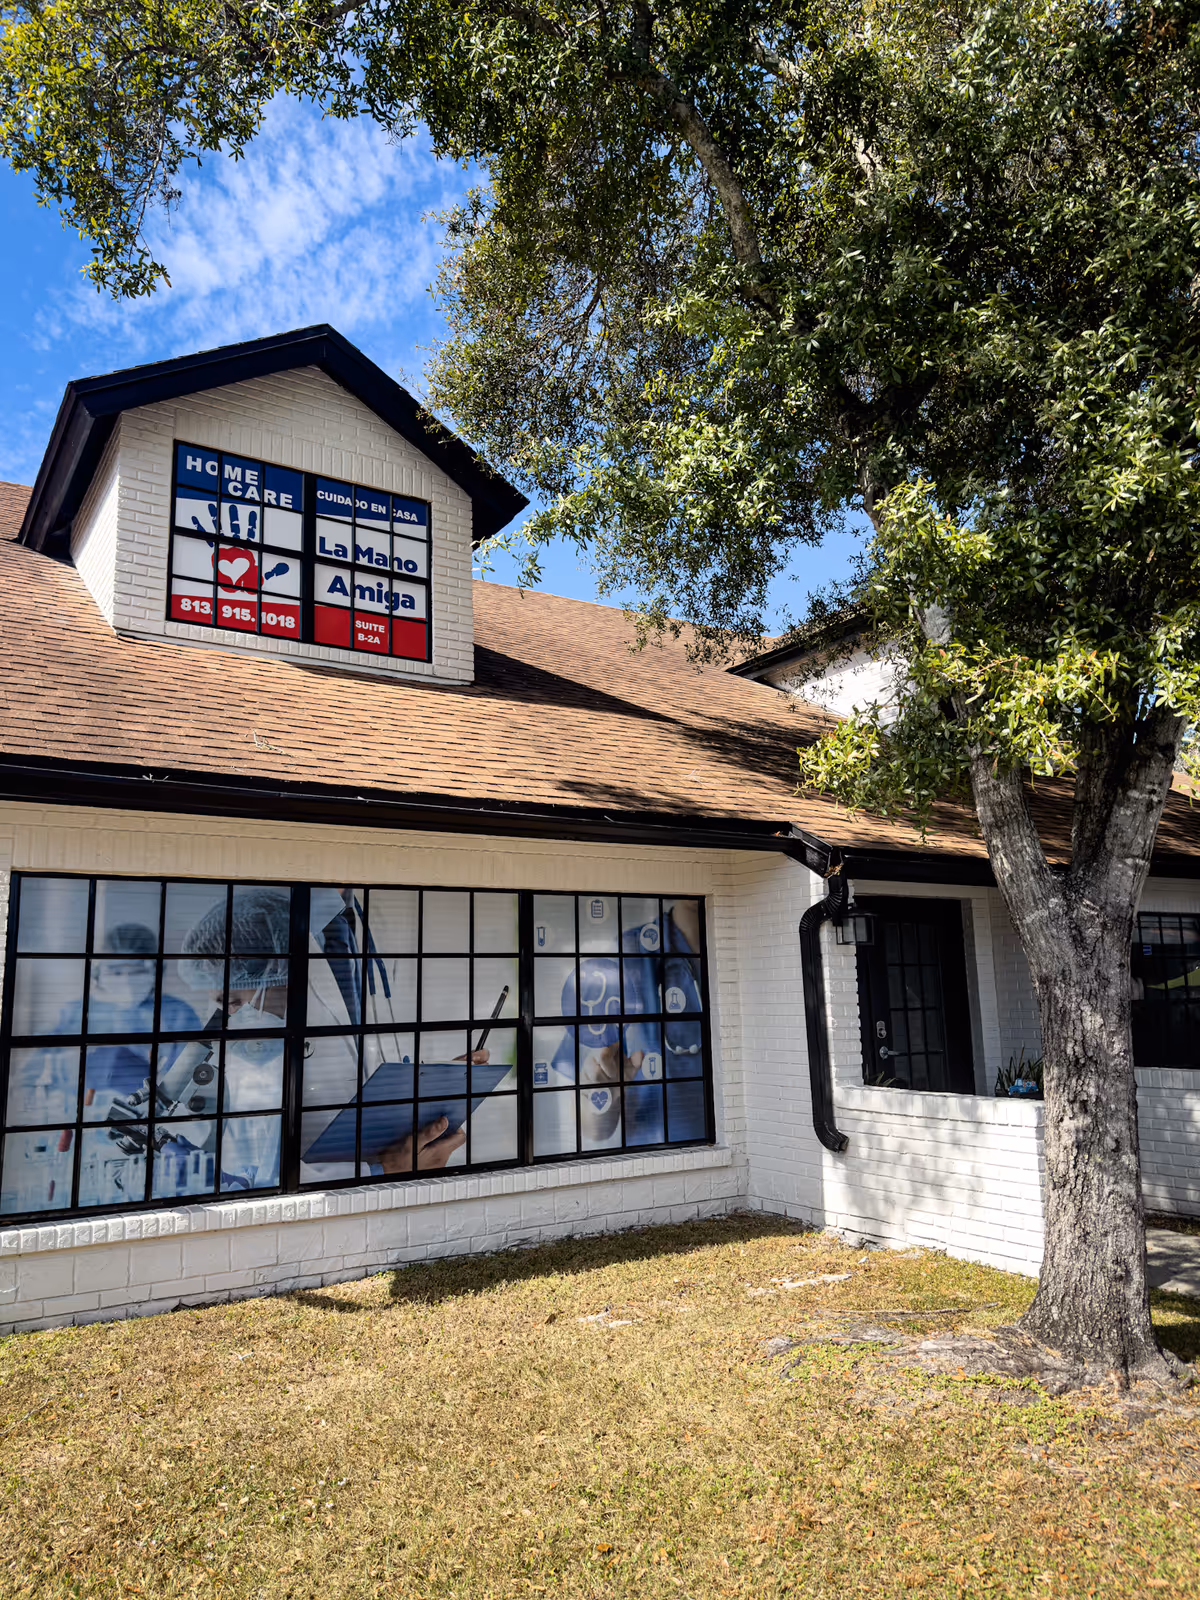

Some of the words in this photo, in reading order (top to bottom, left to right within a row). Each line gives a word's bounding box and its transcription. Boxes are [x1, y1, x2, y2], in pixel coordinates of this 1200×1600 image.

[186, 455, 259, 486] HOME
[228, 481, 293, 509] CARE
[371, 503, 386, 514] EN
[319, 536, 348, 559] La
[355, 544, 418, 573] Mano
[327, 575, 416, 612] Amiga
[355, 620, 385, 633] SUITE
[357, 633, 381, 645] B-2A
